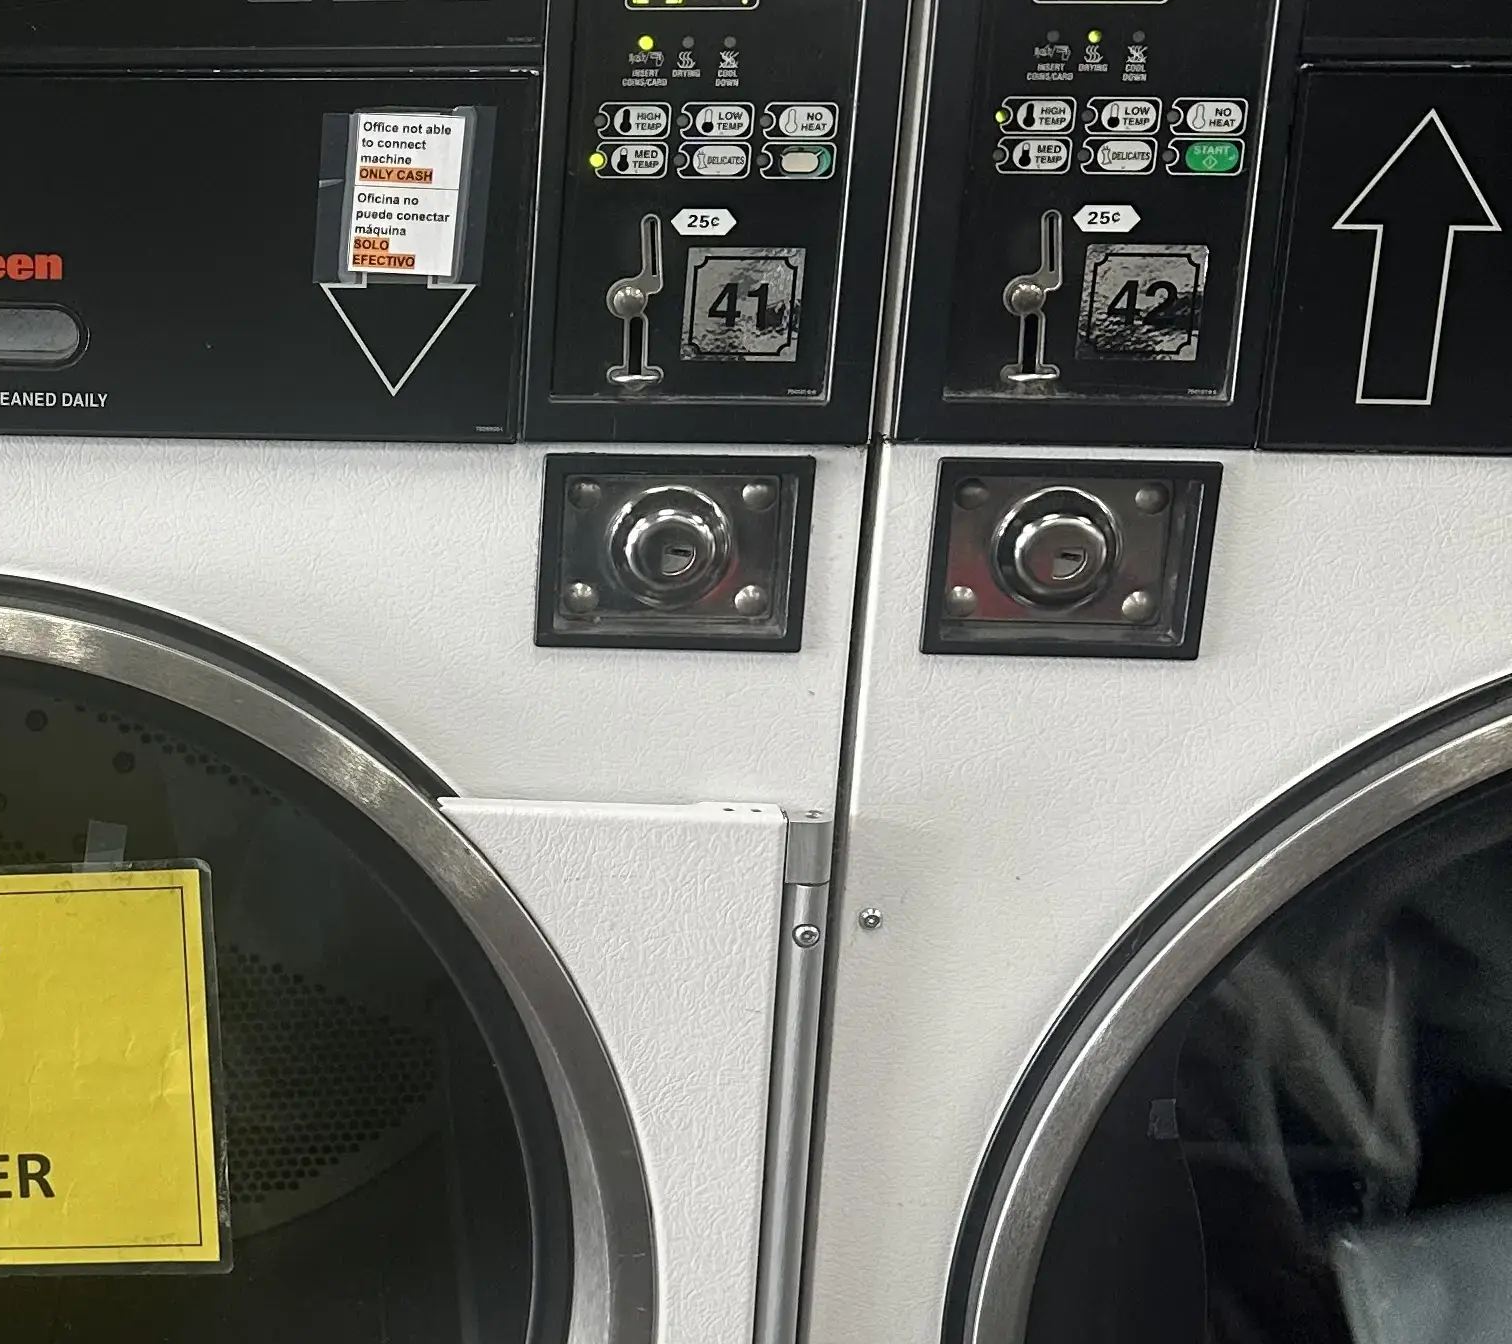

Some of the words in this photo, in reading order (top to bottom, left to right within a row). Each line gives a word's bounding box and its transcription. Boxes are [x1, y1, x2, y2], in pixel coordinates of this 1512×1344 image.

[1040, 106, 1066, 115] HIGH
[1124, 106, 1150, 115] LOW
[1215, 107, 1232, 117] NO
[636, 112, 661, 121] HIGH
[718, 111, 743, 121] LOW
[807, 112, 823, 121] NO
[1039, 116, 1067, 126] TEMP
[636, 122, 662, 131] TEMP
[717, 122, 744, 131] TEMP
[1123, 117, 1150, 126] TEMP
[1209, 117, 1236, 127] HEAT
[363, 121, 399, 133] Office
[402, 124, 423, 134] not
[425, 123, 452, 135] able
[801, 122, 827, 132] HEAT
[362, 138, 374, 148] to
[377, 138, 427, 150] connect
[1037, 144, 1061, 154] MED
[635, 149, 658, 159] MED
[1193, 145, 1231, 155] START
[360, 154, 412, 165] machine
[707, 155, 745, 166] DELICATES
[1035, 154, 1062, 164] TEMP
[1112, 150, 1150, 161] DELICATES
[632, 160, 659, 169] TEMP
[359, 168, 394, 179] ONLY
[396, 169, 433, 182] CASH
[357, 192, 400, 205] Oficina
[403, 197, 419, 205] no
[356, 210, 393, 221] puede
[396, 211, 450, 223] conectar
[687, 214, 720, 229] 25¢
[1087, 211, 1121, 225] 25¢
[354, 224, 407, 237] máquina
[354, 239, 389, 250] SOLO
[352, 254, 416, 267] EFECTIVO
[707, 282, 770, 330] 41
[1107, 280, 1179, 328] 42
[61, 392, 109, 408] DAILY
